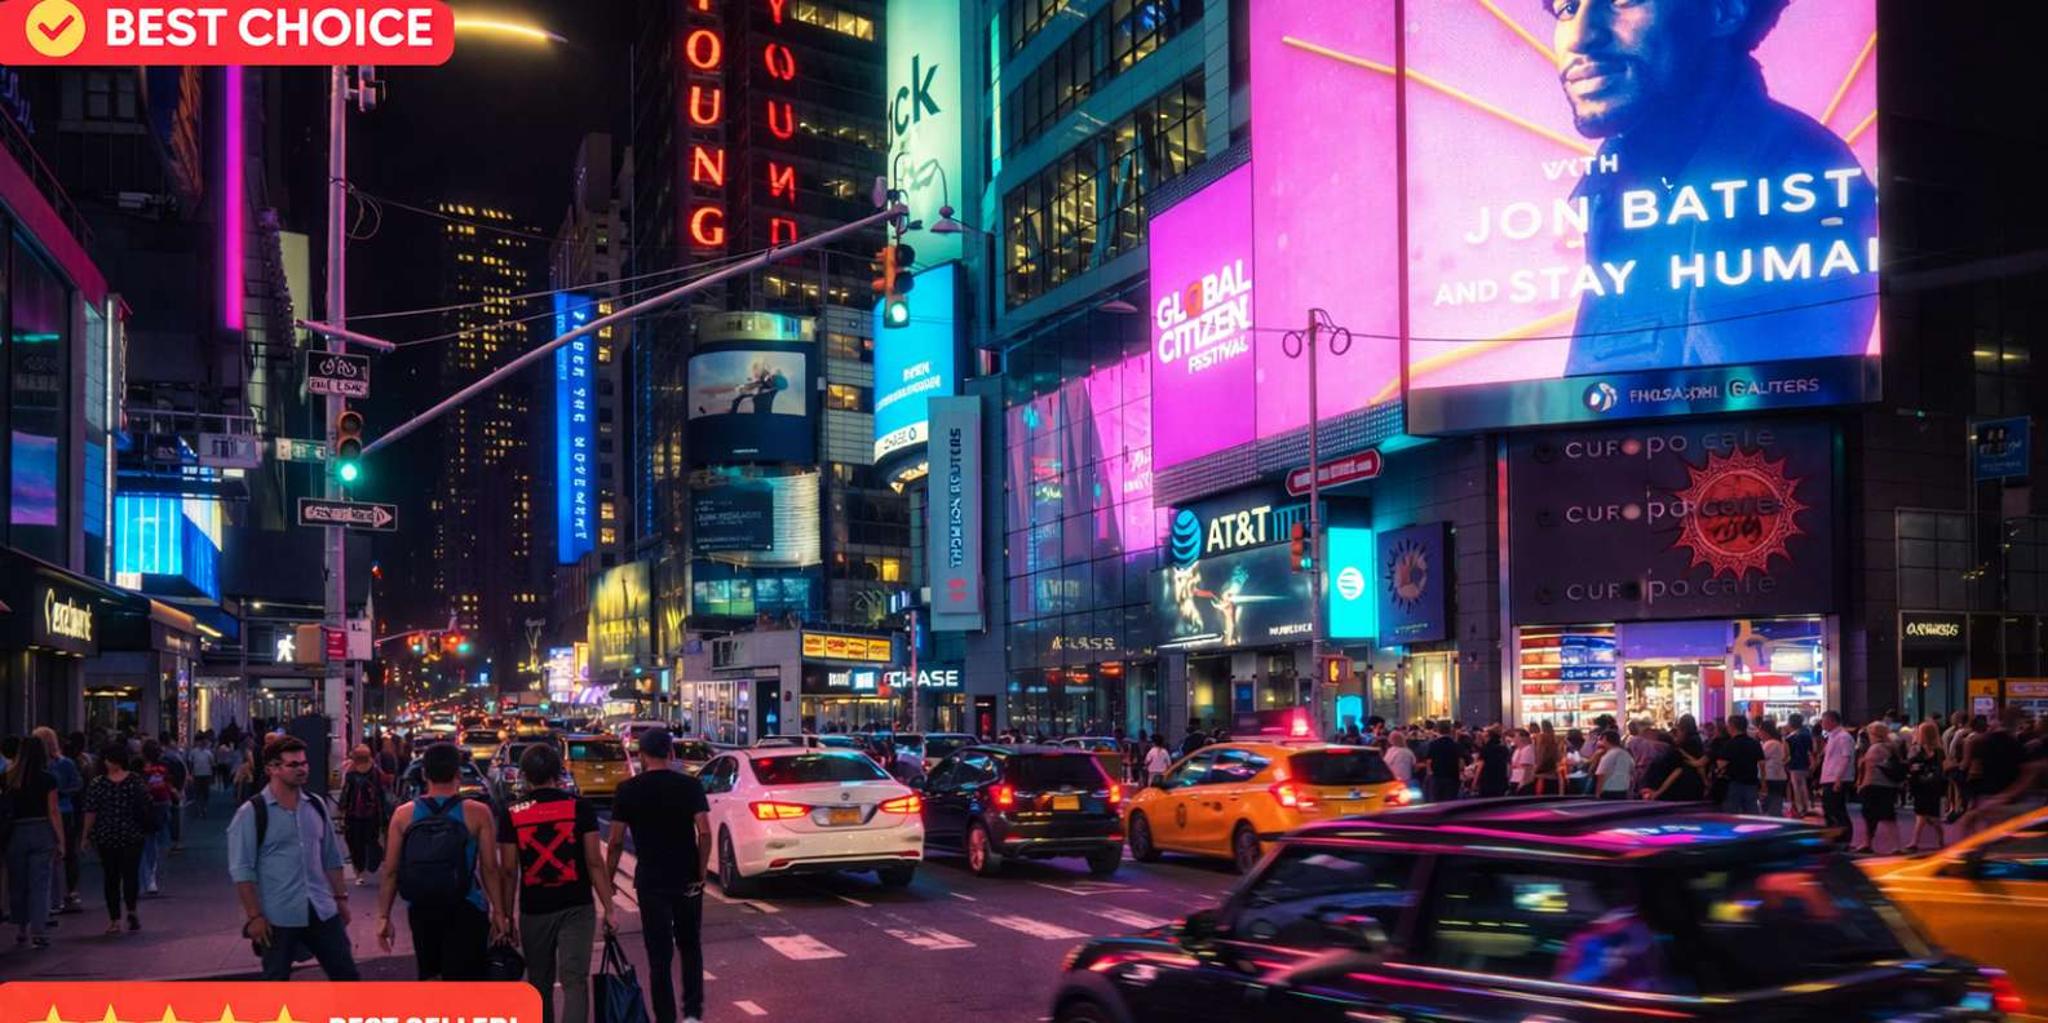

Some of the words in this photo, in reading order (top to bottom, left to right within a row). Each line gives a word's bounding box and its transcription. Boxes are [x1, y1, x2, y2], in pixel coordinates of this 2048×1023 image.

[686, 0, 725, 247] OUNG
[889, 53, 941, 153] ck
[1465, 196, 1589, 244] JON
[1623, 167, 1878, 230] BATIST
[1157, 259, 1253, 330] GLOBAL
[1433, 279, 1498, 307] AND
[1509, 259, 1637, 304] STAY
[1207, 505, 1271, 553] AT&T
[890, 669, 959, 688] CHASE
